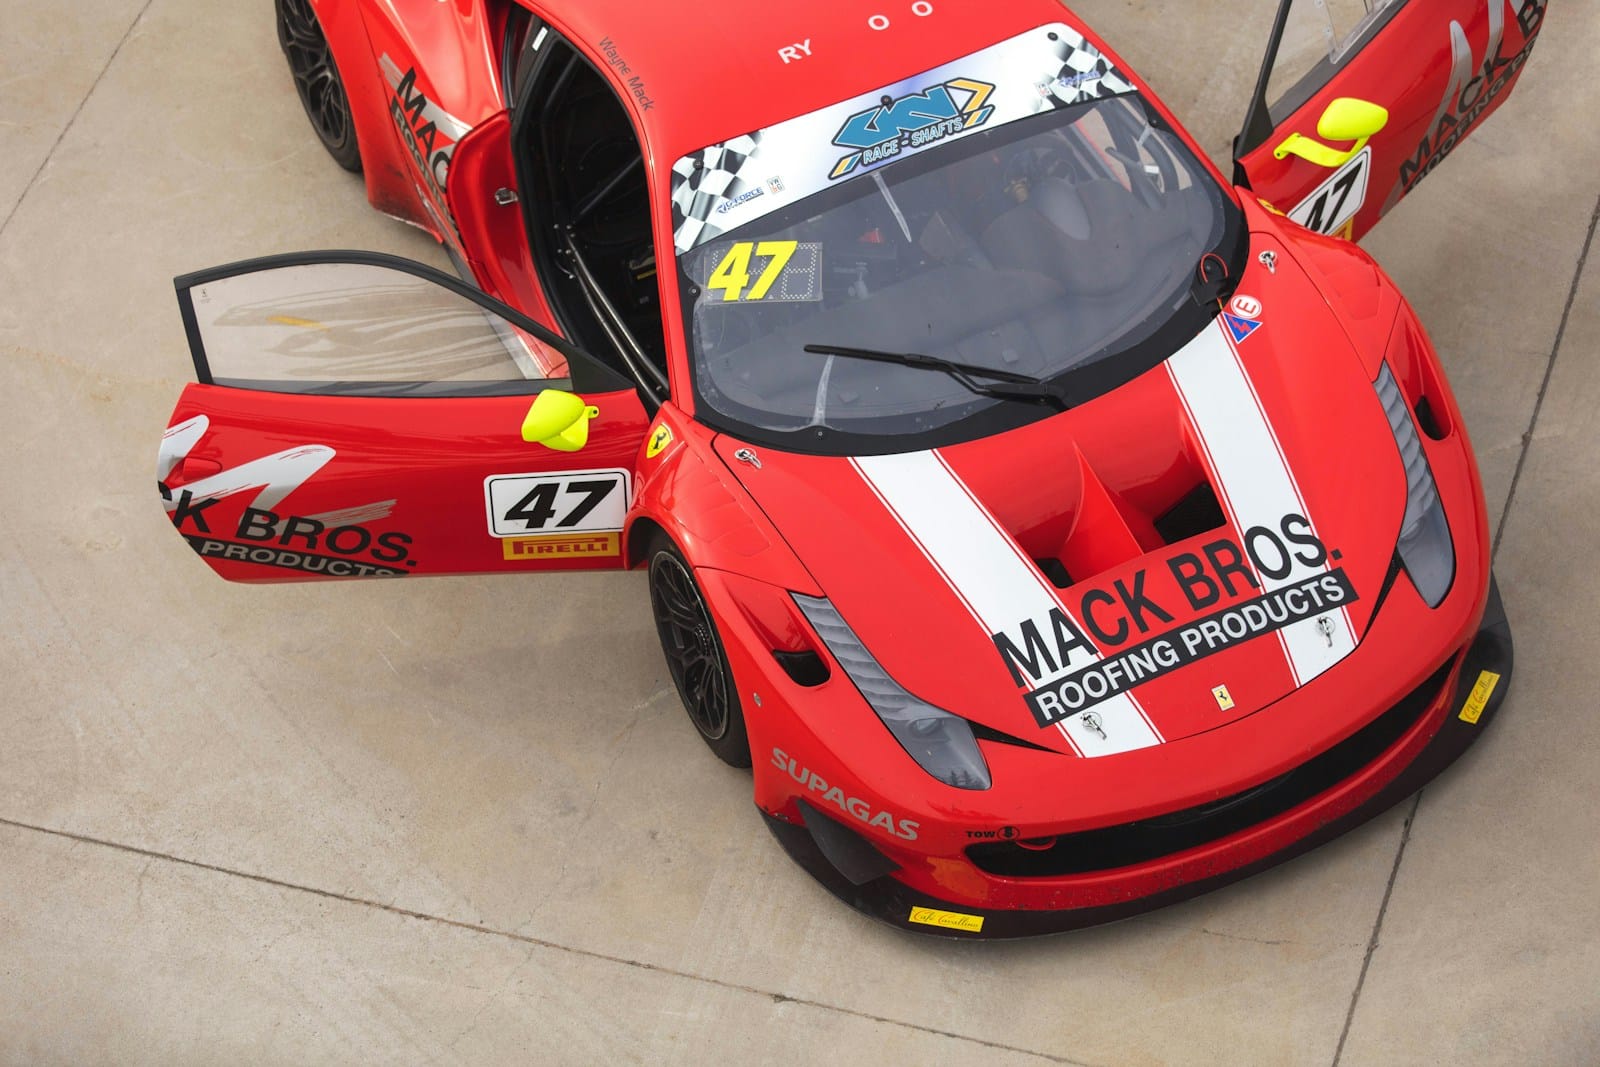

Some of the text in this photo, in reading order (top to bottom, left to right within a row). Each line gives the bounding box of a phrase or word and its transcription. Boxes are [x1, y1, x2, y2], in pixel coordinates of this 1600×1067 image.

[778, 0, 934, 64] RY O O
[599, 36, 654, 111] Wayne Mack
[863, 139, 899, 165] RACE
[911, 117, 964, 147] SHAFTS
[1399, 37, 1513, 187] MACK
[707, 241, 798, 301] 47
[504, 480, 618, 529] 47
[236, 507, 417, 567] BROS.
[513, 537, 608, 555] PIRELLI
[992, 513, 1343, 688] MACK BROS.
[1035, 576, 1345, 721] ROOFING PRODUCTS
[770, 747, 920, 841] SUPAGAS
[965, 830, 996, 839] TOW
